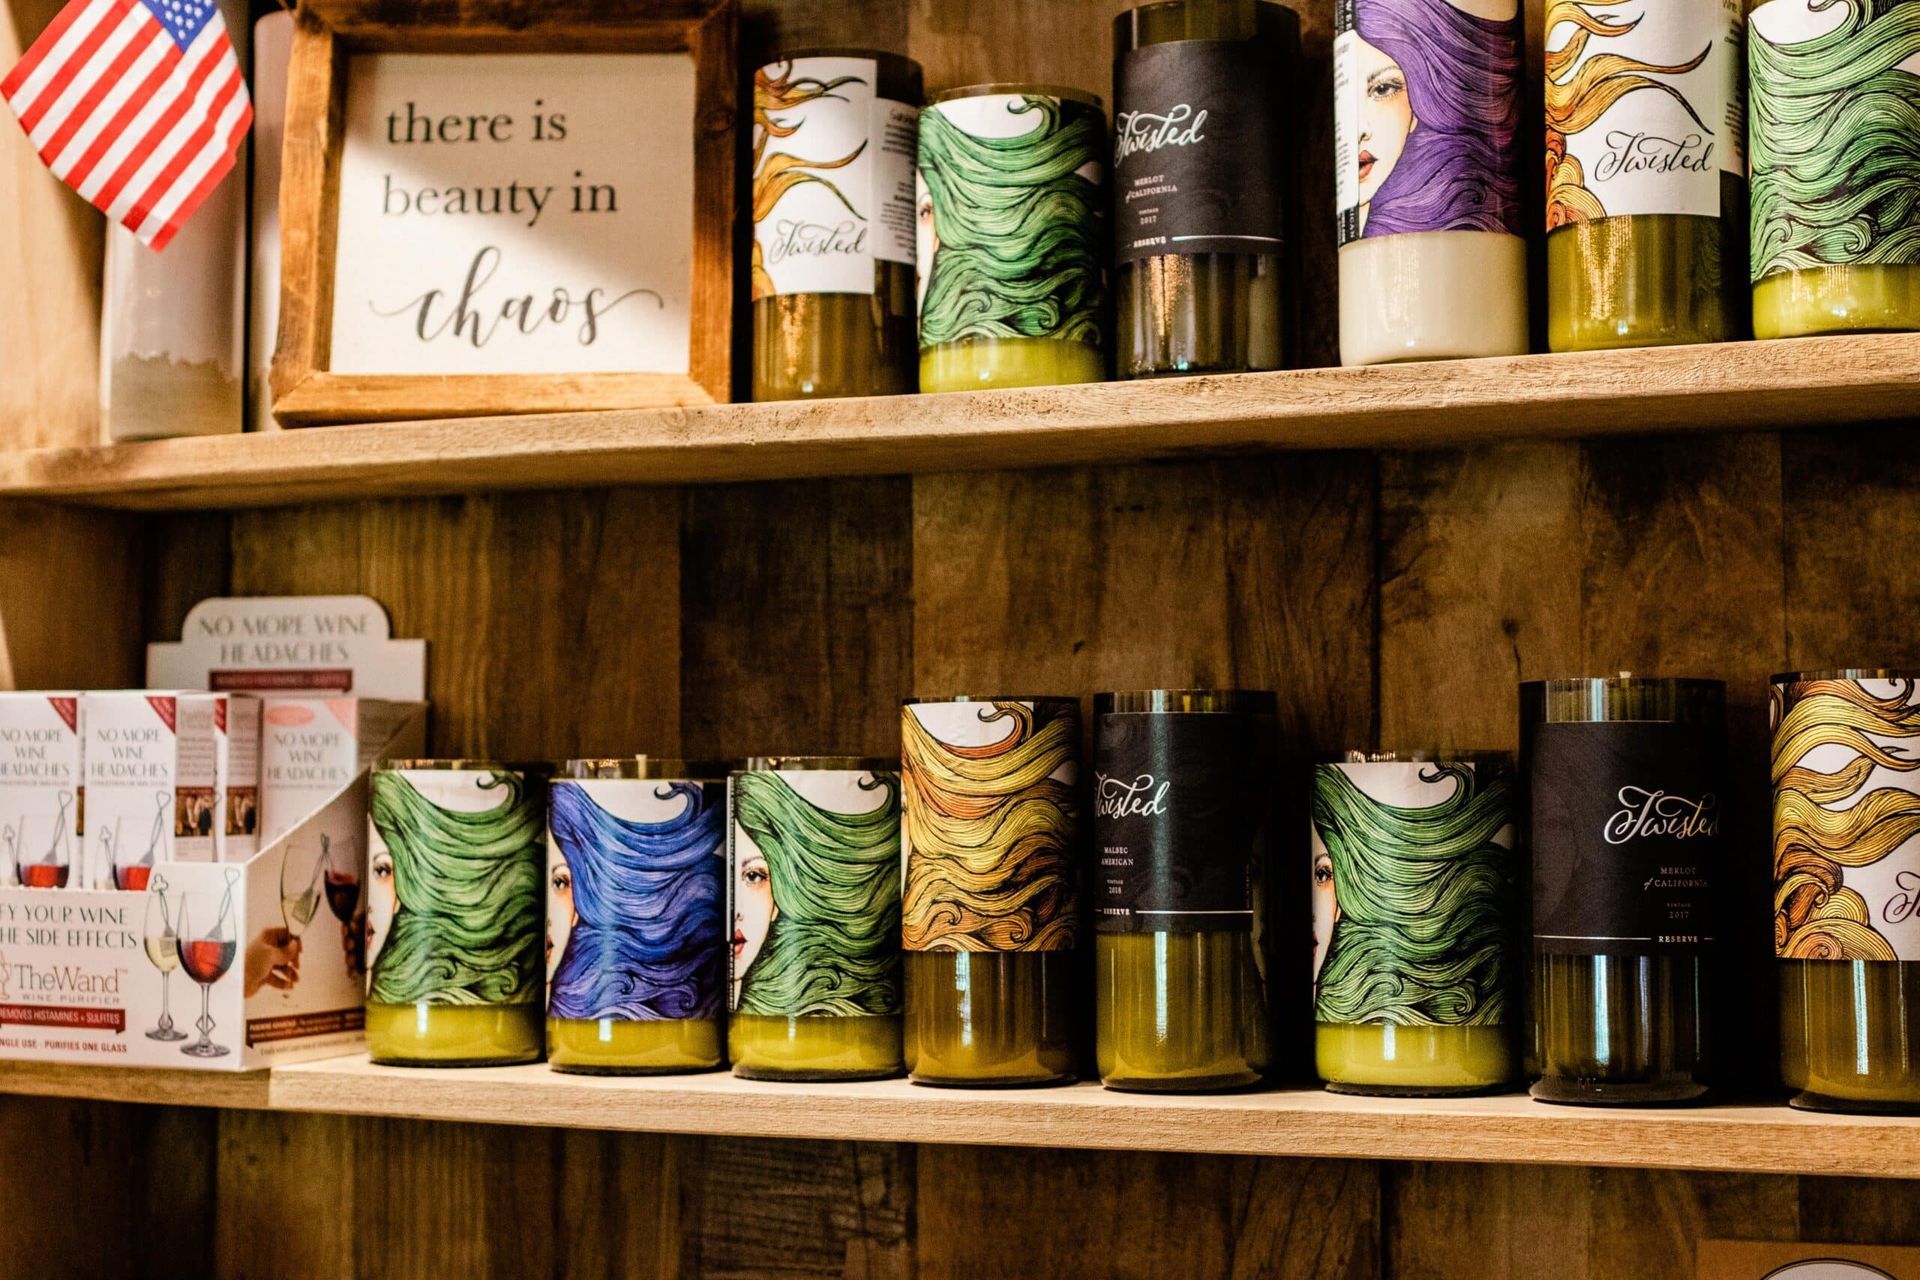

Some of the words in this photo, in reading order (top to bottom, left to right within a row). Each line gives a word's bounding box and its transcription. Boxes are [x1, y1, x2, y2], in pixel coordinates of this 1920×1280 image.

[386, 101, 513, 144] there
[531, 99, 567, 141] is
[1114, 103, 1208, 169] Twisted
[1594, 129, 1715, 183] Twisted
[383, 173, 553, 228] beauty
[570, 170, 618, 213] in
[1131, 184, 1178, 199] CALIFORNIA
[768, 219, 868, 265] Twisted
[369, 246, 665, 348] chaos
[200, 614, 234, 636] NO
[242, 613, 303, 635] MORE
[313, 613, 369, 634] WINE
[219, 642, 350, 664] HEADACHES
[1, 728, 21, 742] NO
[24, 728, 63, 742] MORE
[97, 728, 118, 742] NO
[121, 728, 159, 742] MORE
[274, 732, 298, 746] NO
[300, 732, 341, 747] MORE
[14, 745, 46, 759] WINE
[111, 745, 143, 759] WINE
[287, 749, 322, 763] WINE
[91, 761, 168, 777] HEADACHES
[266, 766, 349, 782] HEADACHES
[1101, 858, 1134, 866] AMERICAN
[1660, 866, 1697, 875] MERLOT
[1109, 886, 1122, 895] 2018
[1654, 879, 1709, 888] CALIFORNIA
[24, 903, 72, 922] YOUR
[79, 906, 127, 924] WINE
[1668, 911, 1689, 919] 2017
[26, 928, 60, 946] SIDE
[67, 930, 138, 949] EFFECTS
[1658, 935, 1699, 943] RESERVE
[33, 1009, 79, 1022] HISTAMINES
[86, 1011, 120, 1024] SULFITES
[21, 1039, 37, 1049] USE
[44, 1040, 79, 1051] PURIFIES
[82, 1041, 97, 1052] ONE
[100, 1042, 127, 1053] GLASS
